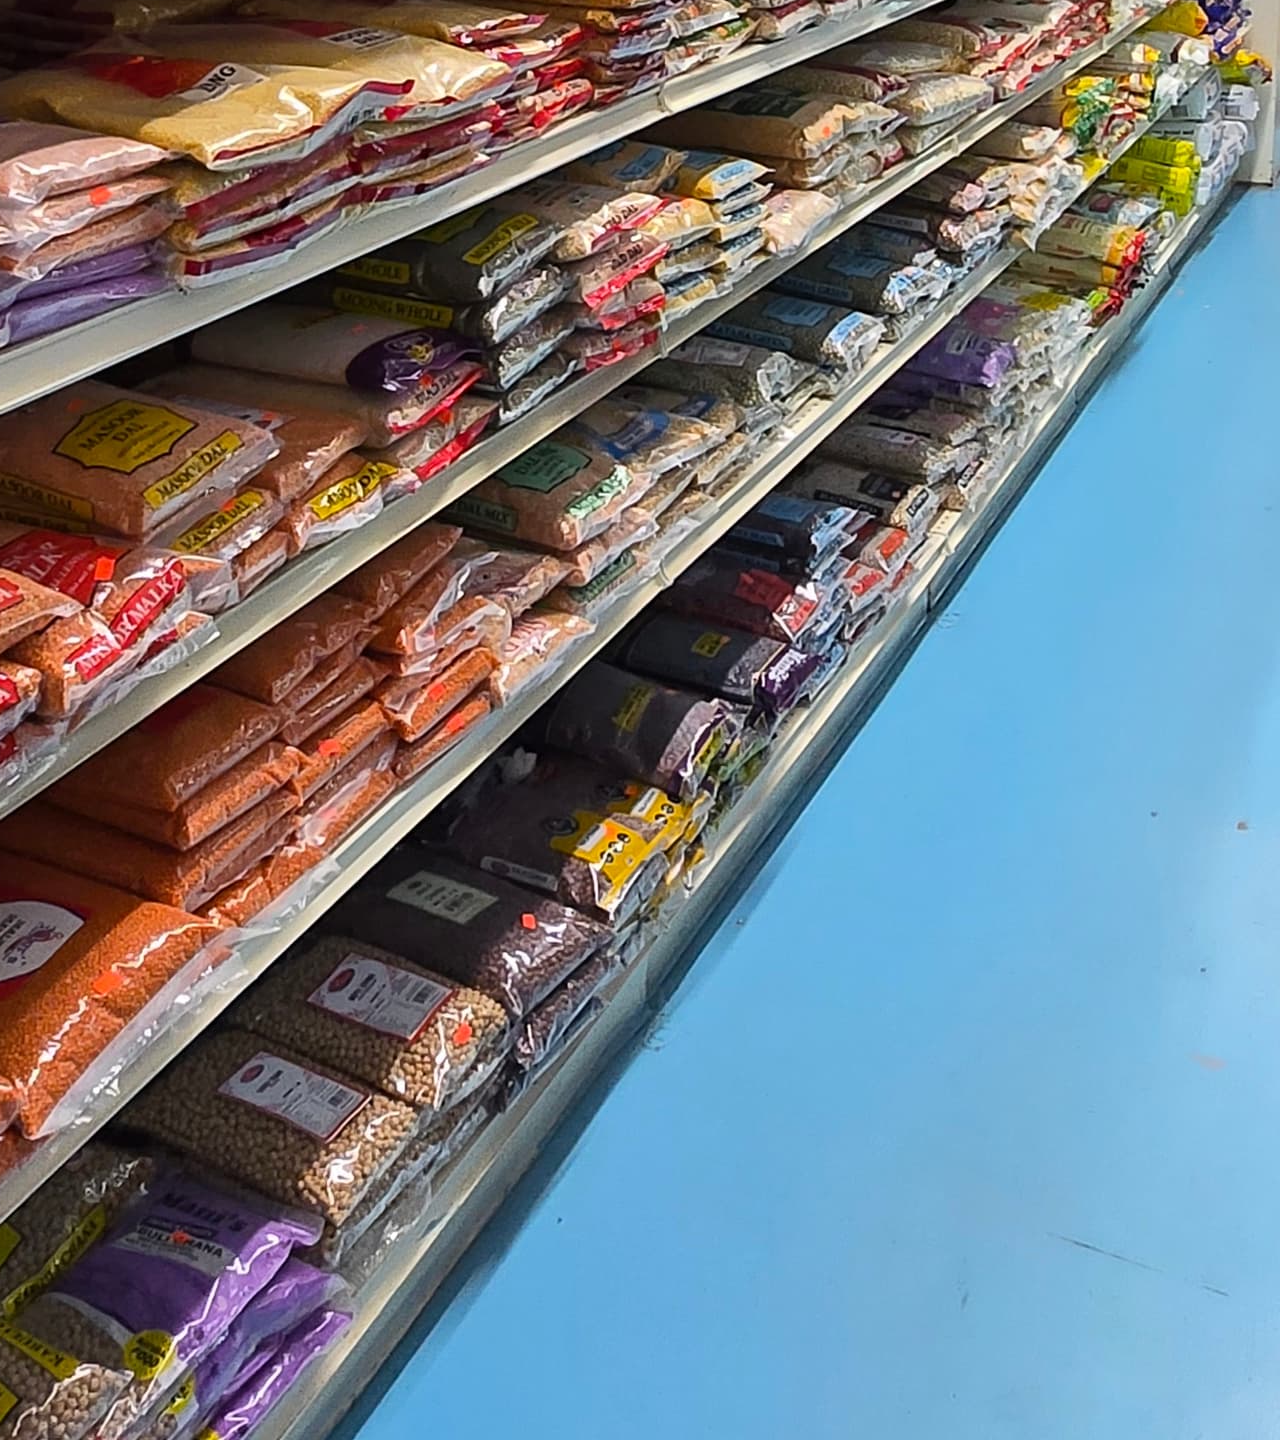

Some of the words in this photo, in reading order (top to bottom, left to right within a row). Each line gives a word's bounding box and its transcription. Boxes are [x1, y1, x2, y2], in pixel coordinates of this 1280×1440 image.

[78, 407, 145, 452] MASOOR
[113, 420, 149, 443] DAL
[199, 442, 229, 467] DAL
